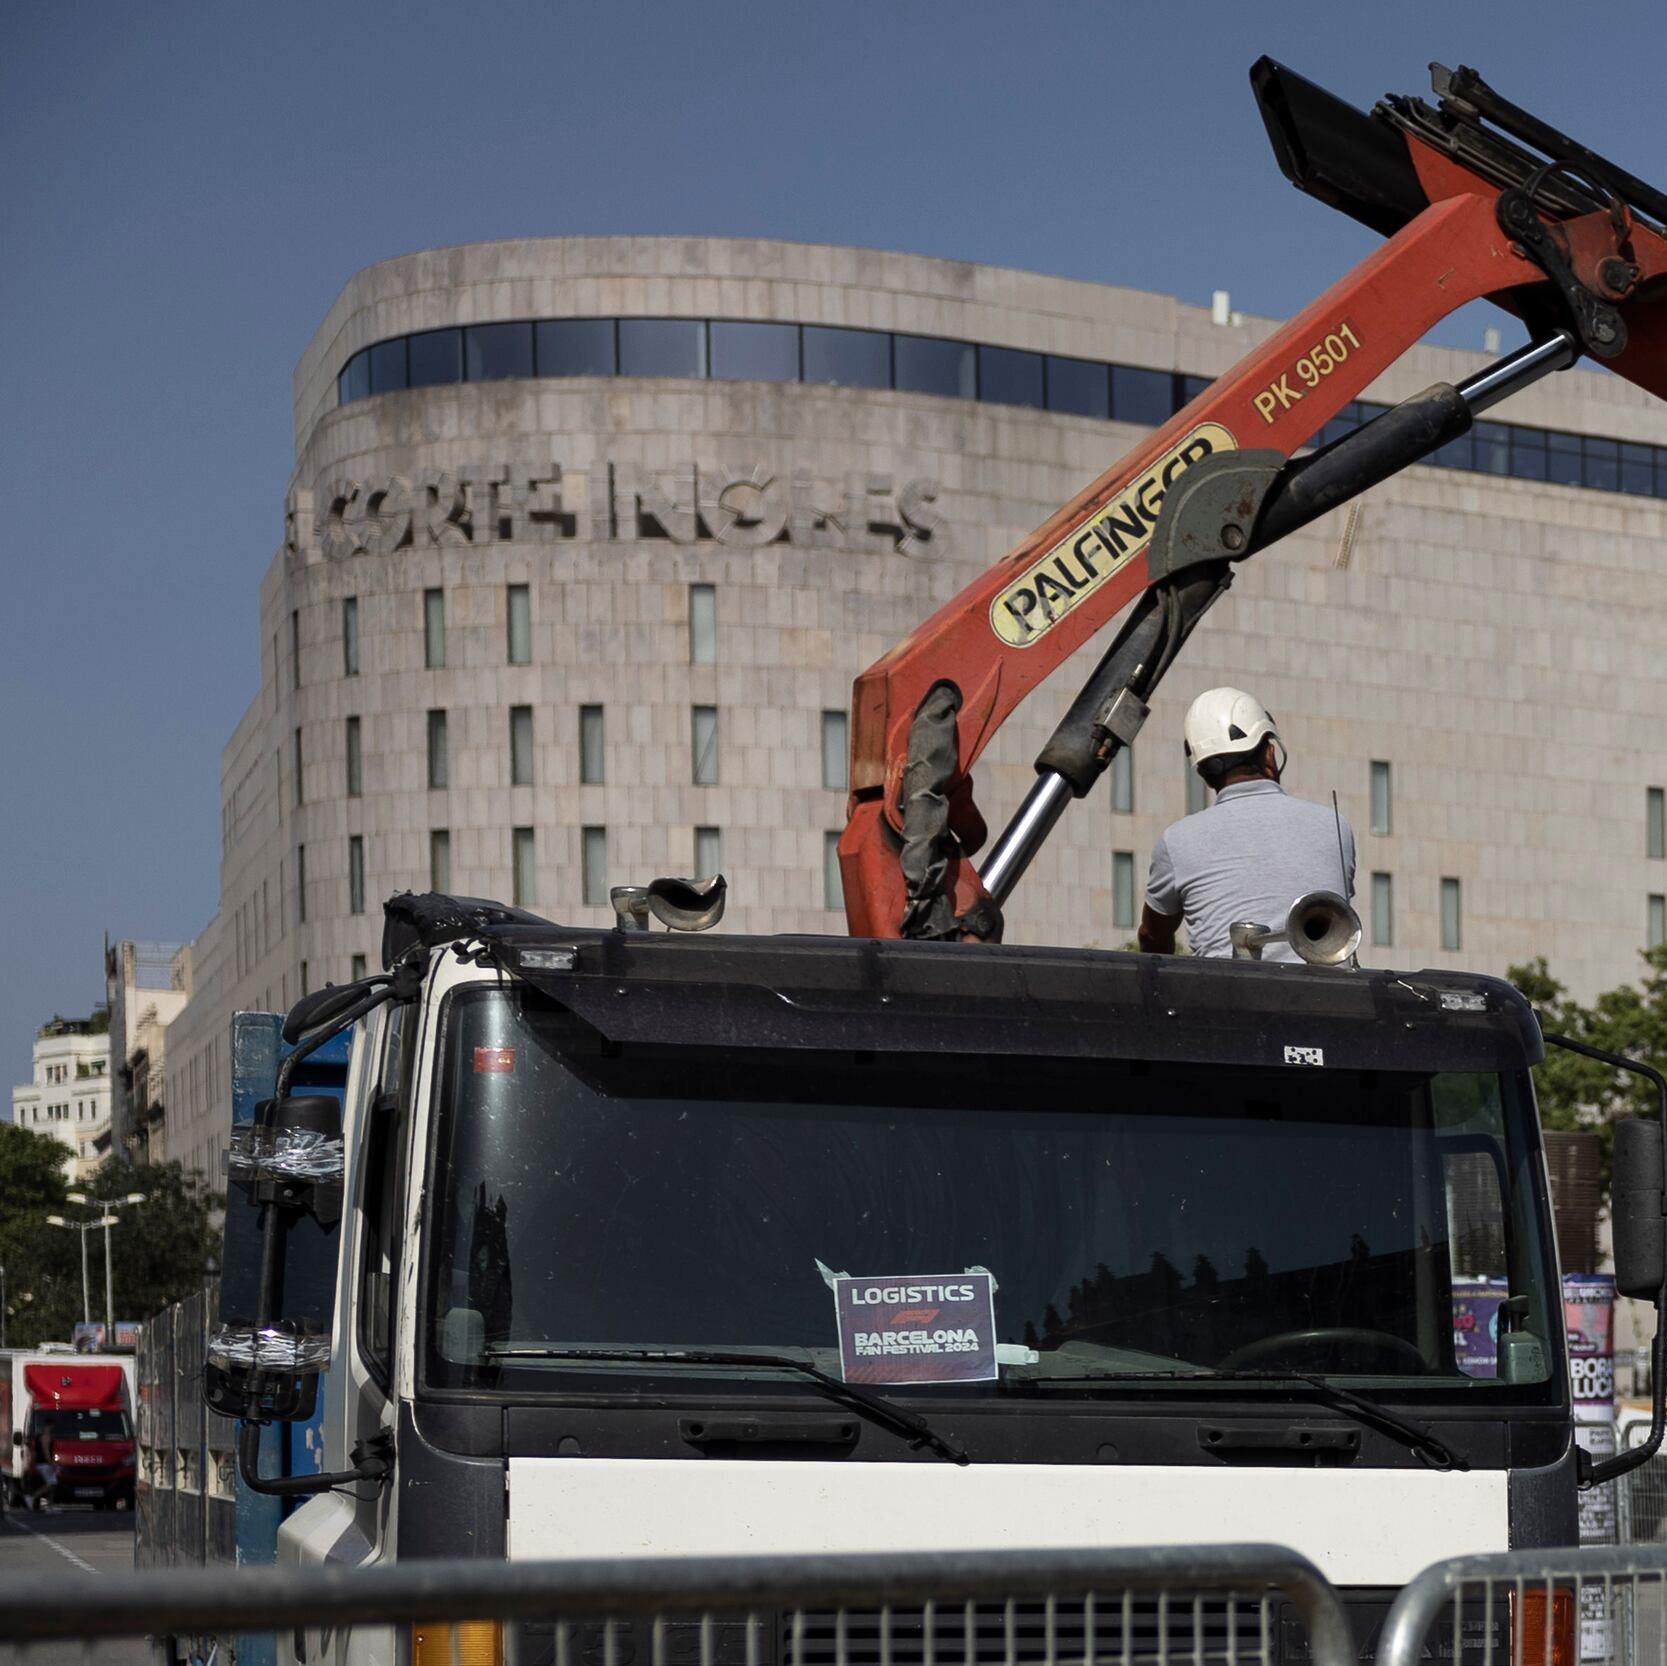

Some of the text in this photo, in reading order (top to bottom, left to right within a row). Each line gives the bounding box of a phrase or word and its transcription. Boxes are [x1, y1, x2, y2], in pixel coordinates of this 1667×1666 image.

[1253, 322, 1362, 425] PK 9501
[313, 461, 577, 561] CORTE
[851, 1284, 976, 1306] LOGISTICS
[854, 1328, 980, 1347] BARCELONA
[855, 1342, 979, 1356] FAN FESTIVAL 2024
